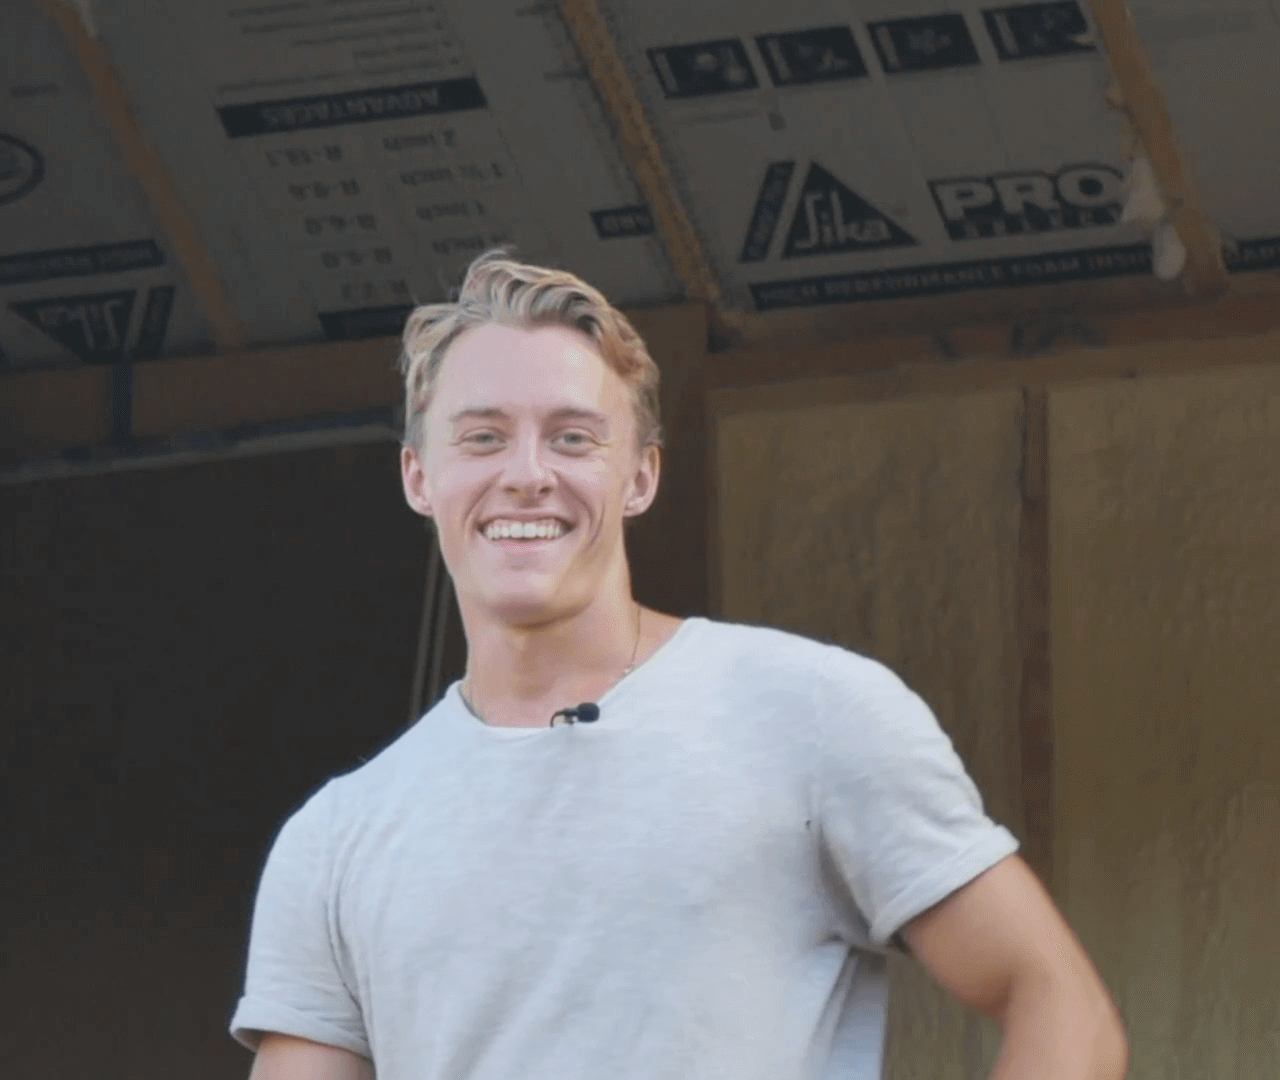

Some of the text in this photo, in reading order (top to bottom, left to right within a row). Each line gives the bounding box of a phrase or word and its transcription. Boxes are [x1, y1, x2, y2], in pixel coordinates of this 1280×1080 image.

[261, 88, 439, 126] ADVANTAGES
[794, 190, 893, 249] Sika
[933, 166, 1122, 221] PRO
